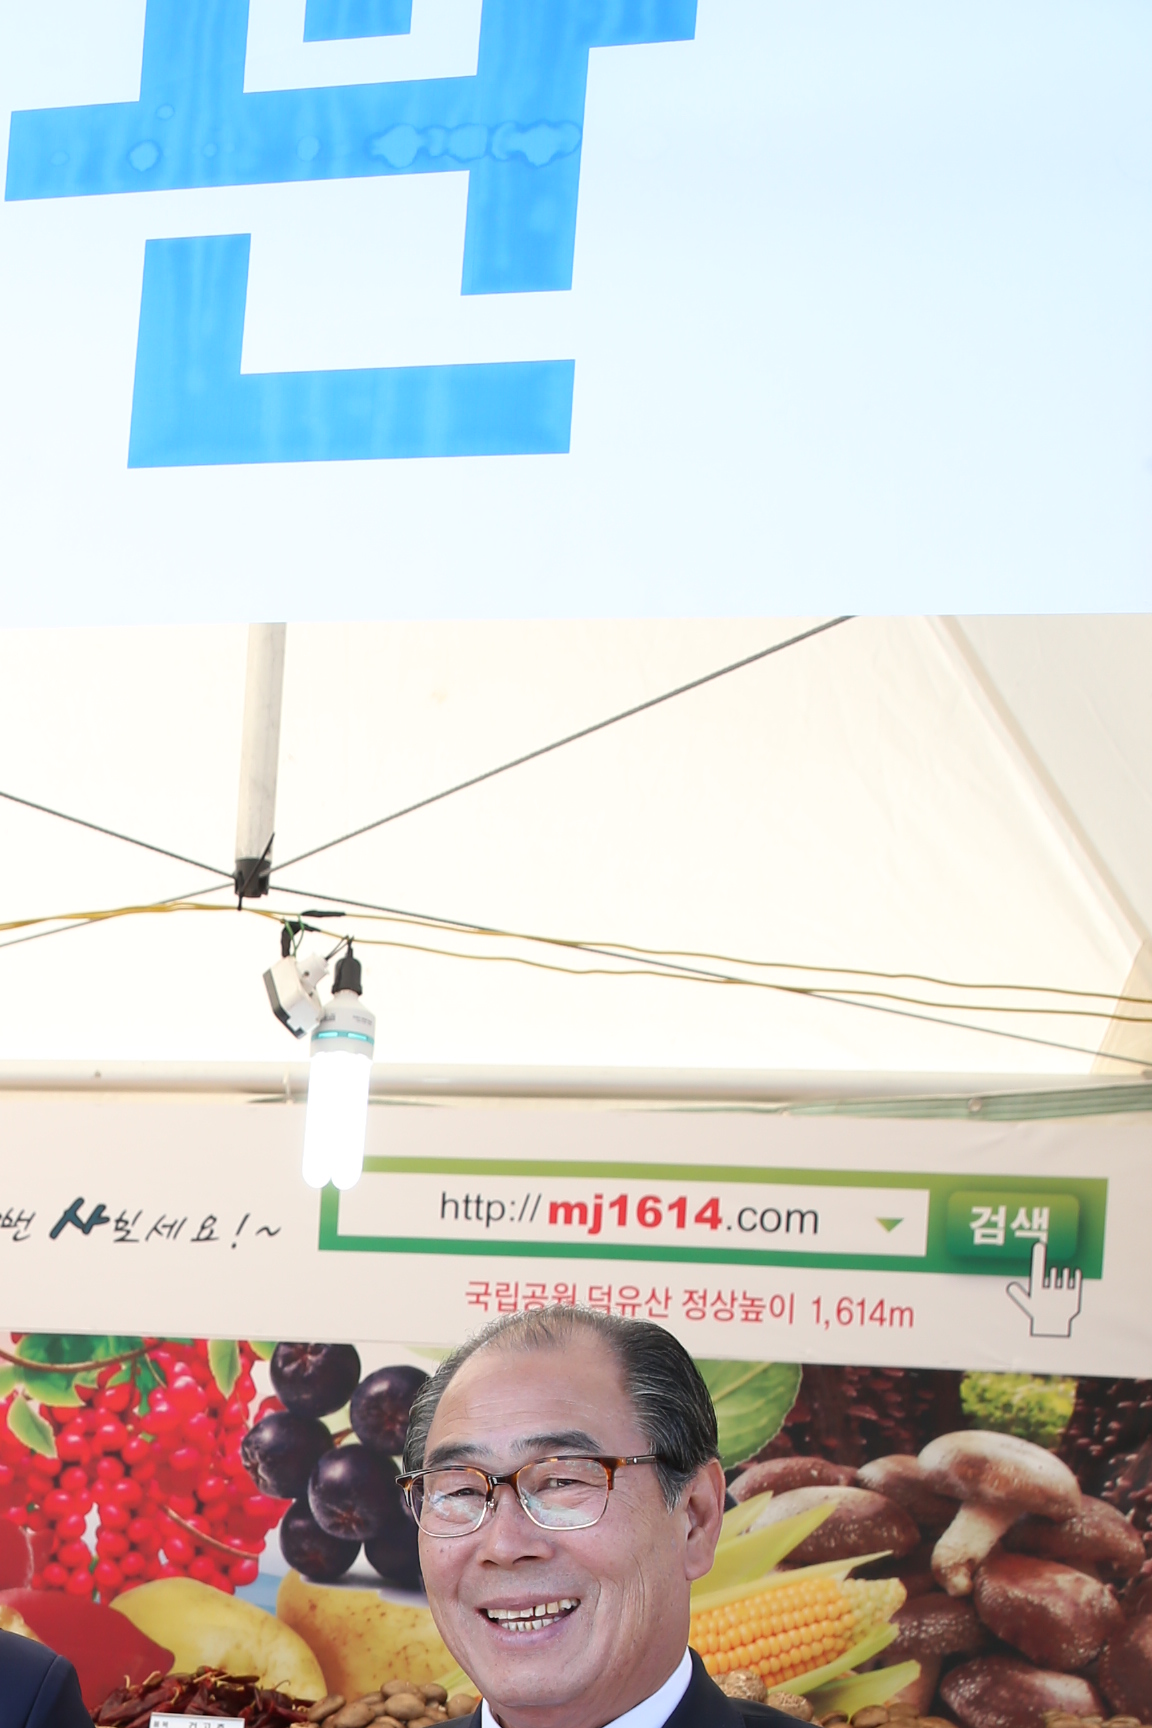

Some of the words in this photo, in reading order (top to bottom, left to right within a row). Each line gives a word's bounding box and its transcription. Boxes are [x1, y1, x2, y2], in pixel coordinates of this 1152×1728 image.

[440, 1191, 819, 1236] http://mj1614.com
[969, 1205, 1050, 1247] 검색
[465, 1281, 576, 1313] 국립공원
[588, 1285, 672, 1319] 덕유산
[682, 1288, 794, 1325] 정상높이
[811, 1297, 915, 1331] 1,614m
